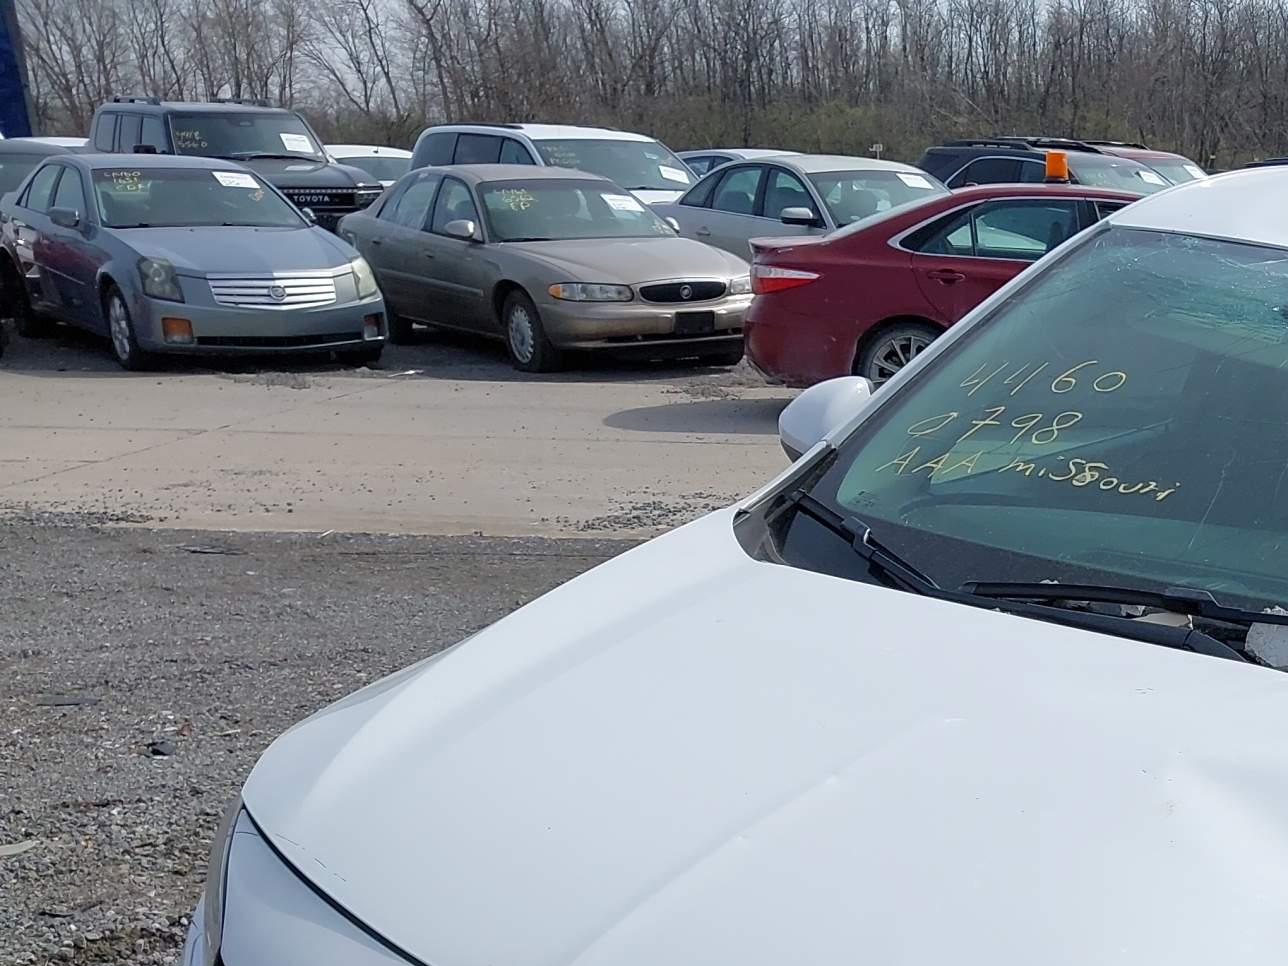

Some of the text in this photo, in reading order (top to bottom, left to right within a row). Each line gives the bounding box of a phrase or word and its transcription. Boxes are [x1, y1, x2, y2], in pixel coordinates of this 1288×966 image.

[293, 195, 330, 203] TOYOTA
[960, 359, 1127, 397] 4460
[907, 406, 1083, 446] 0798
[875, 446, 985, 478] AAA
